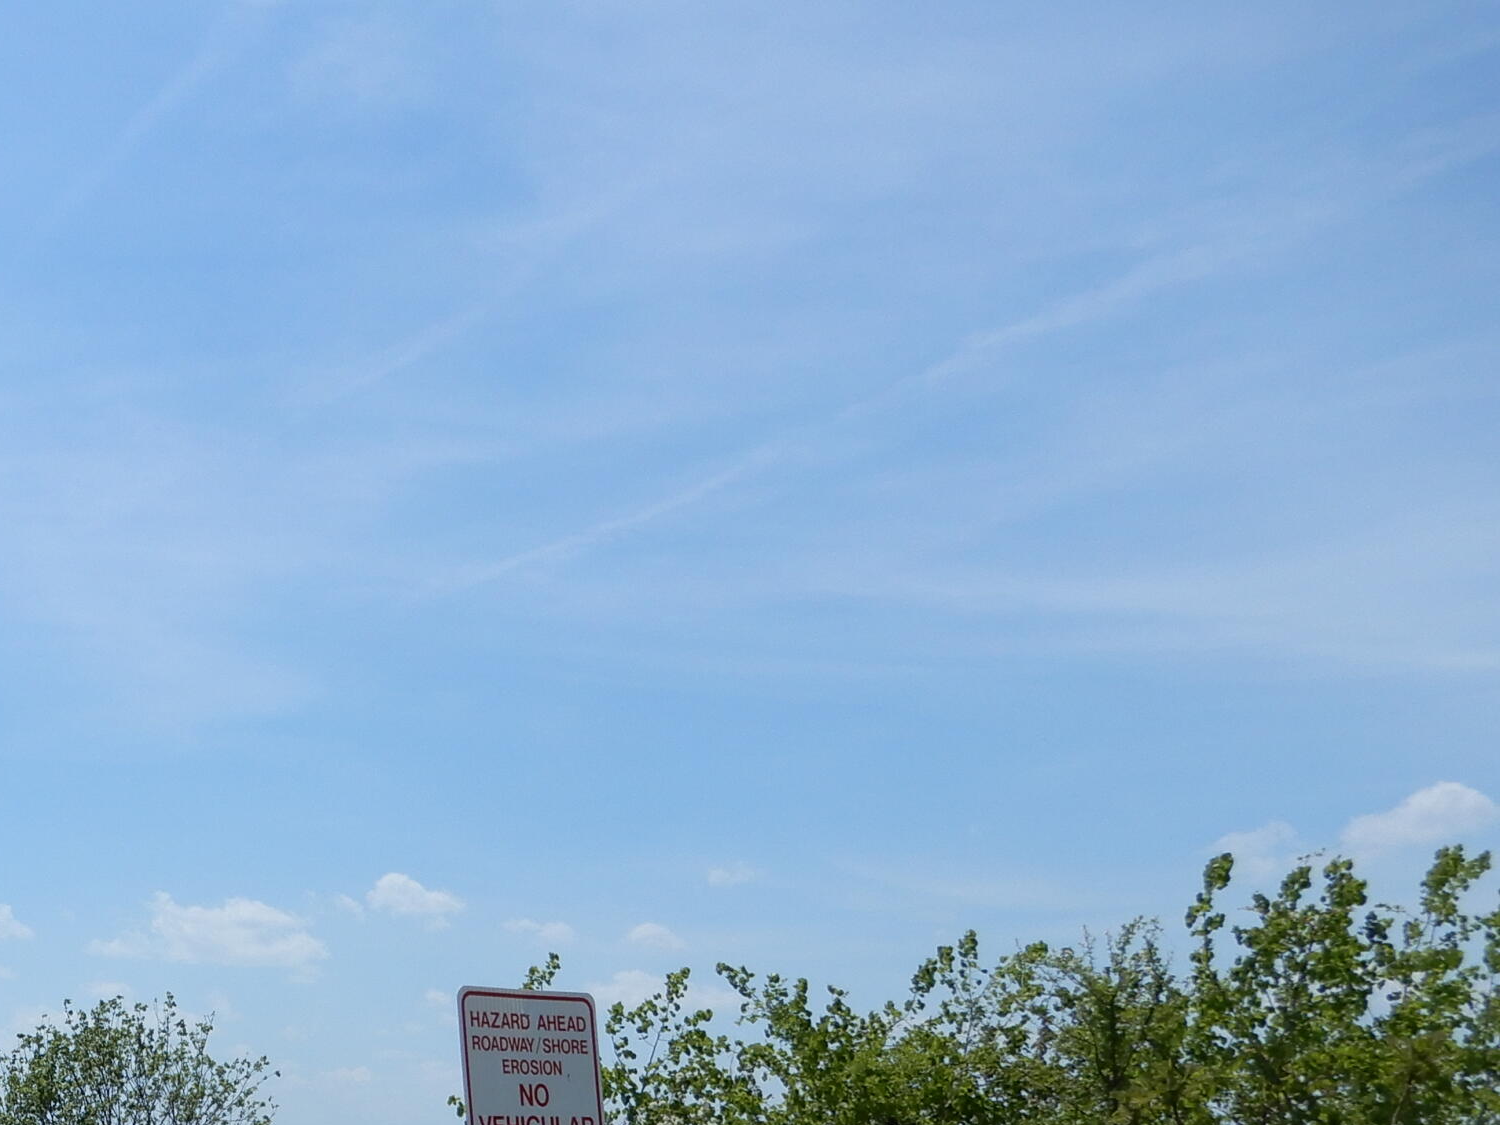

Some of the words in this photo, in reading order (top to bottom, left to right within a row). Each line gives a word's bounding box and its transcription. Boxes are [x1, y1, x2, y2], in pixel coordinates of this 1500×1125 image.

[470, 1011, 530, 1030] HAZARD
[537, 1015, 586, 1032] AHEAD
[502, 1059, 562, 1075] EROSION
[519, 1083, 549, 1107] NO
